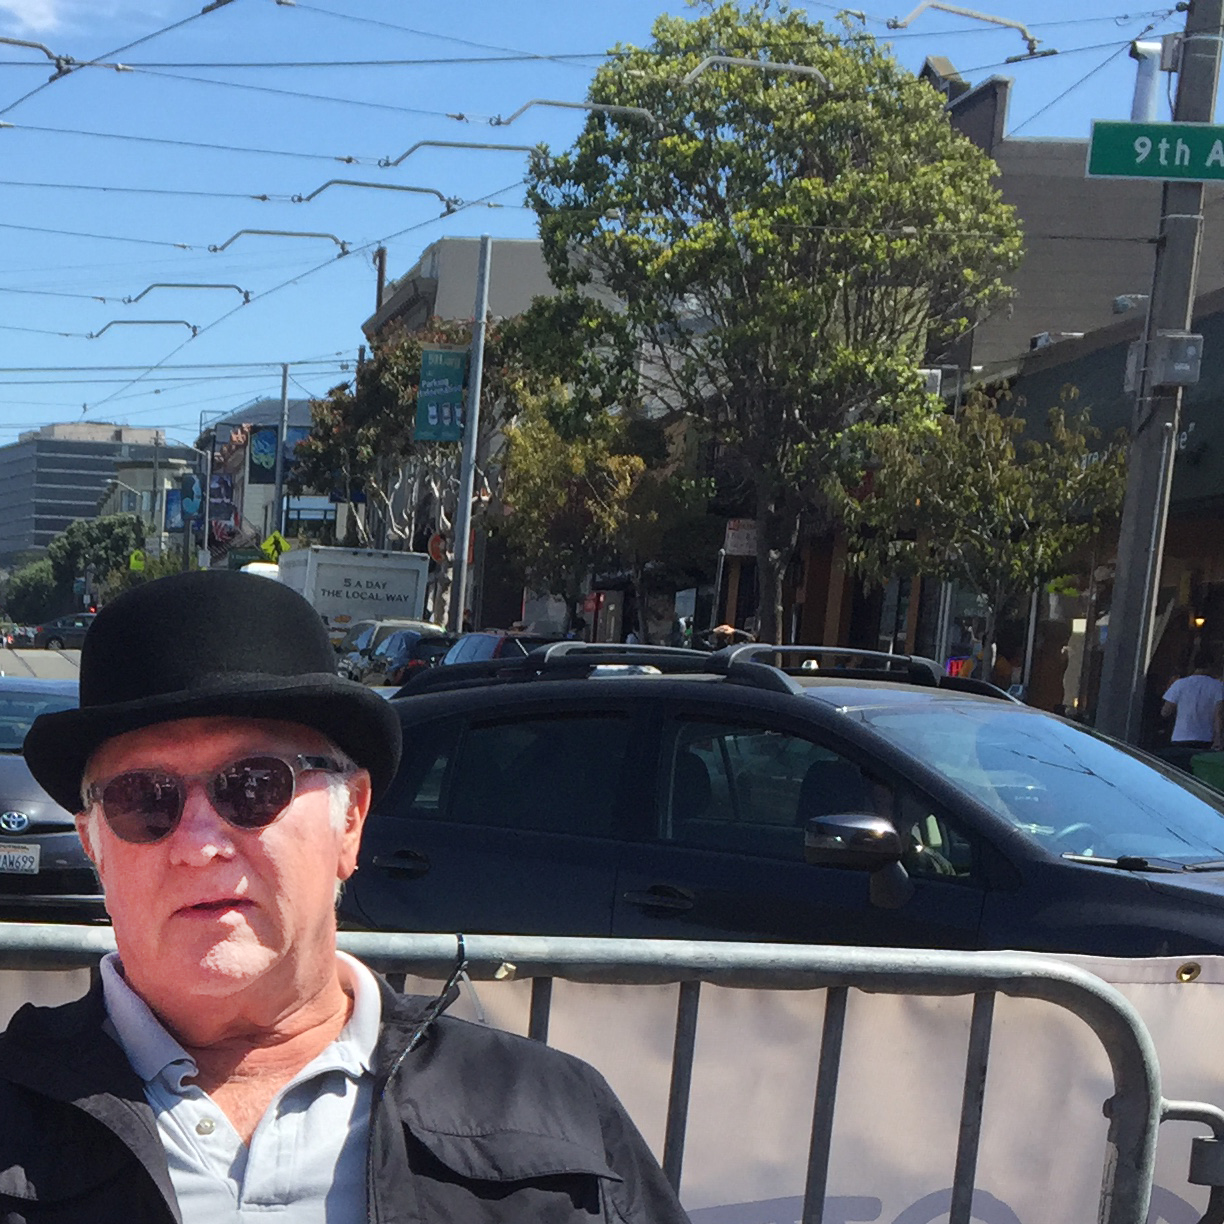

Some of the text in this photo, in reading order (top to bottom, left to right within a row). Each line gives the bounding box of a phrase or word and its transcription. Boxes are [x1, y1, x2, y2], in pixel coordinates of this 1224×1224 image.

[1134, 136, 1190, 165] 9th
[343, 578, 387, 590] 5 A DAY
[321, 588, 409, 602] THE LOCAL WAY
